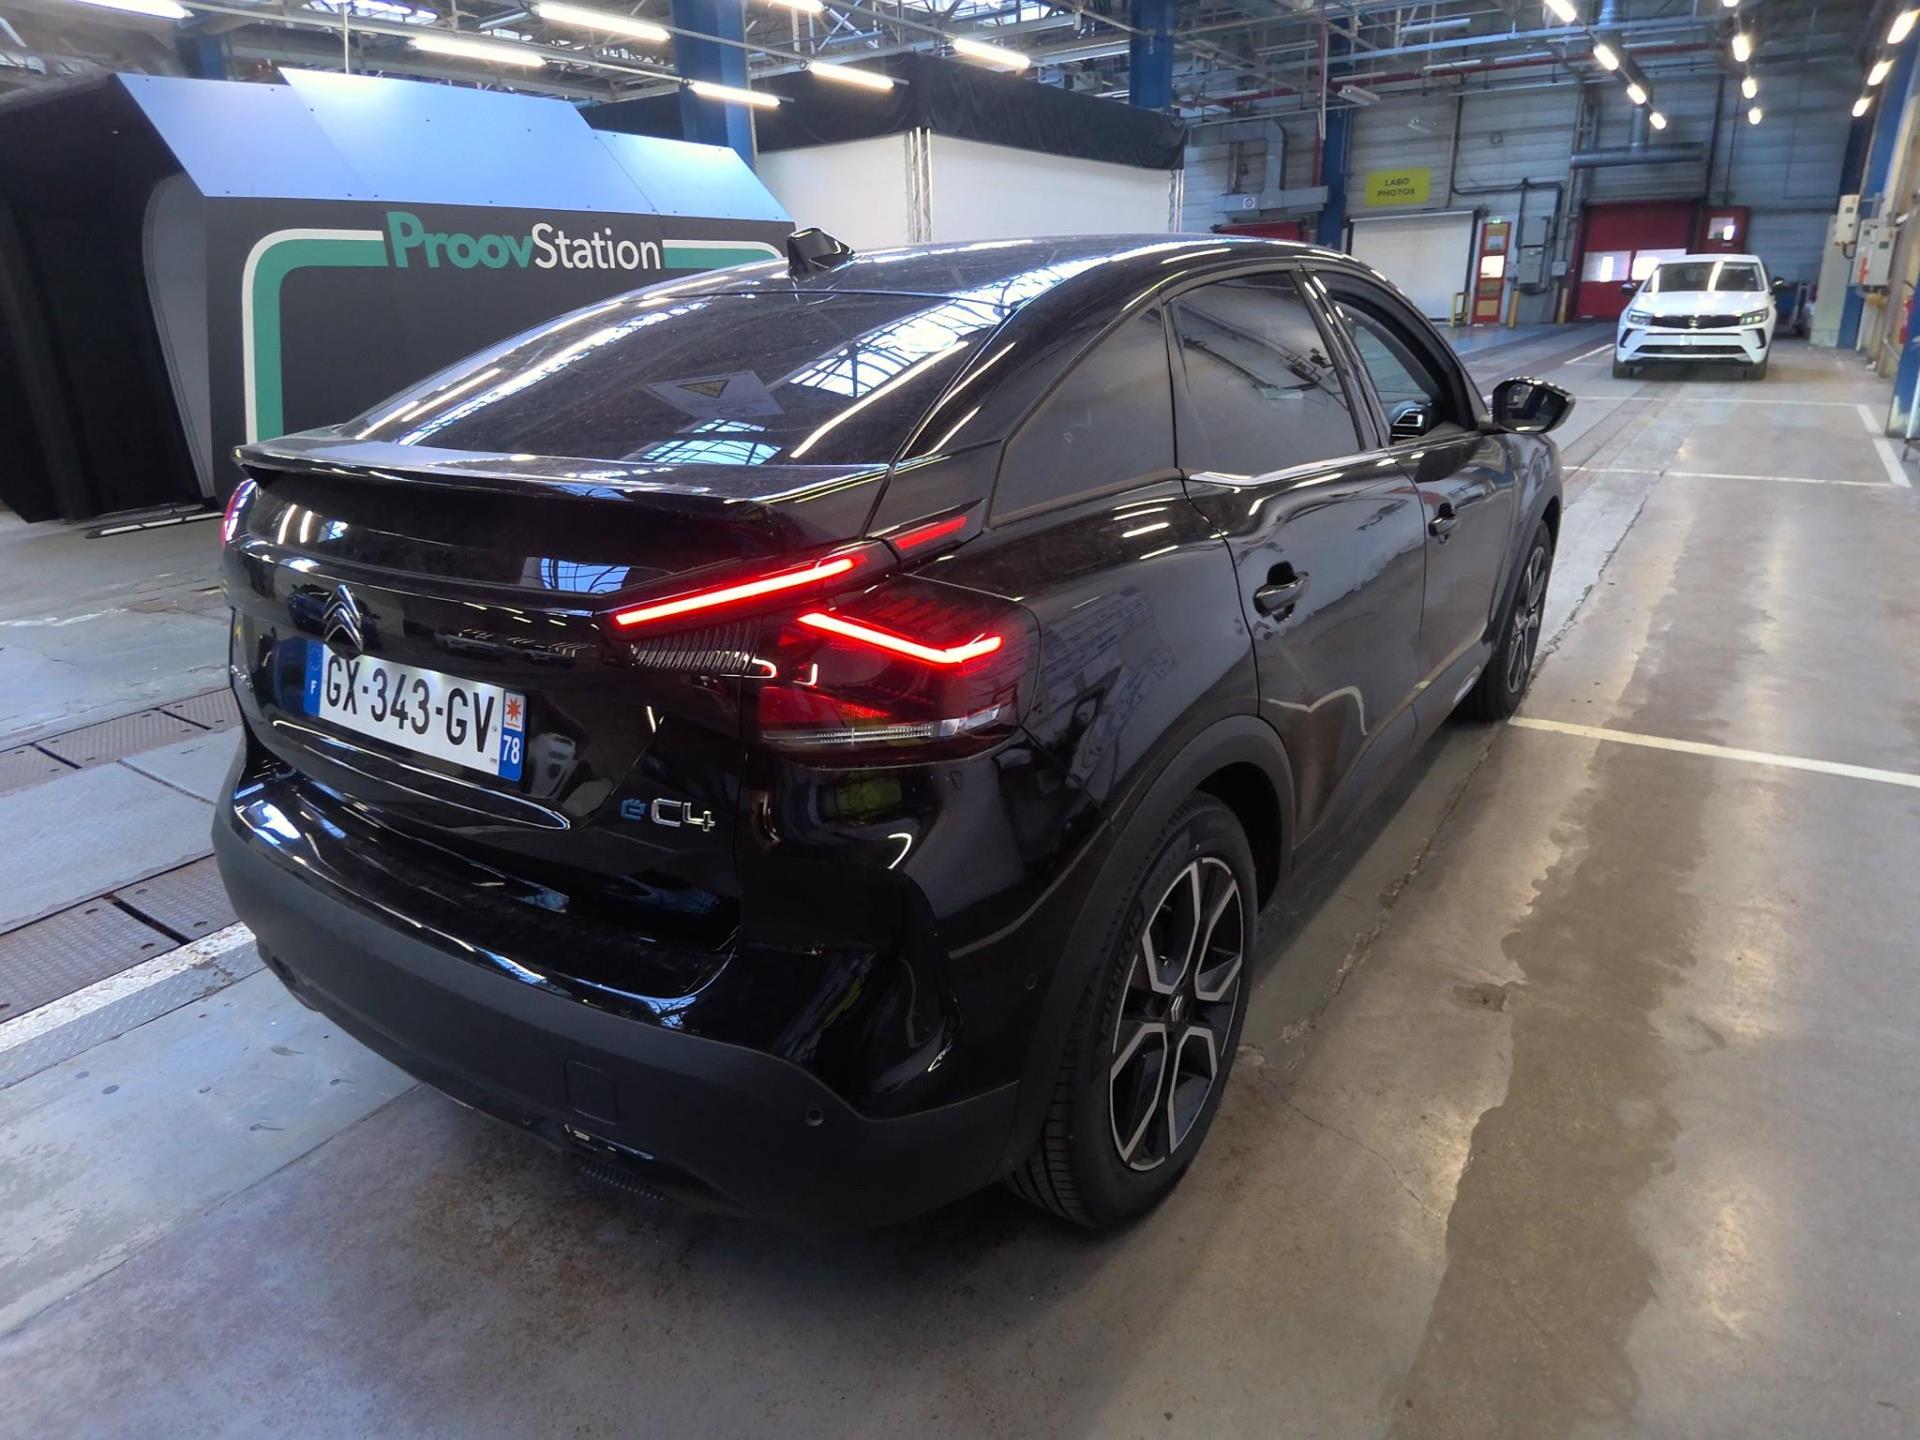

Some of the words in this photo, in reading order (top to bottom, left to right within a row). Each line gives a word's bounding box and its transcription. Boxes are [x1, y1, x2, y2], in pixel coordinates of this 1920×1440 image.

[1378, 188, 1415, 196] PHOTOS
[1385, 178, 1409, 186] LABO
[386, 211, 661, 270] ProovStation
[310, 679, 318, 695] F
[326, 655, 495, 753] GX-343-GV
[503, 735, 521, 764] 78
